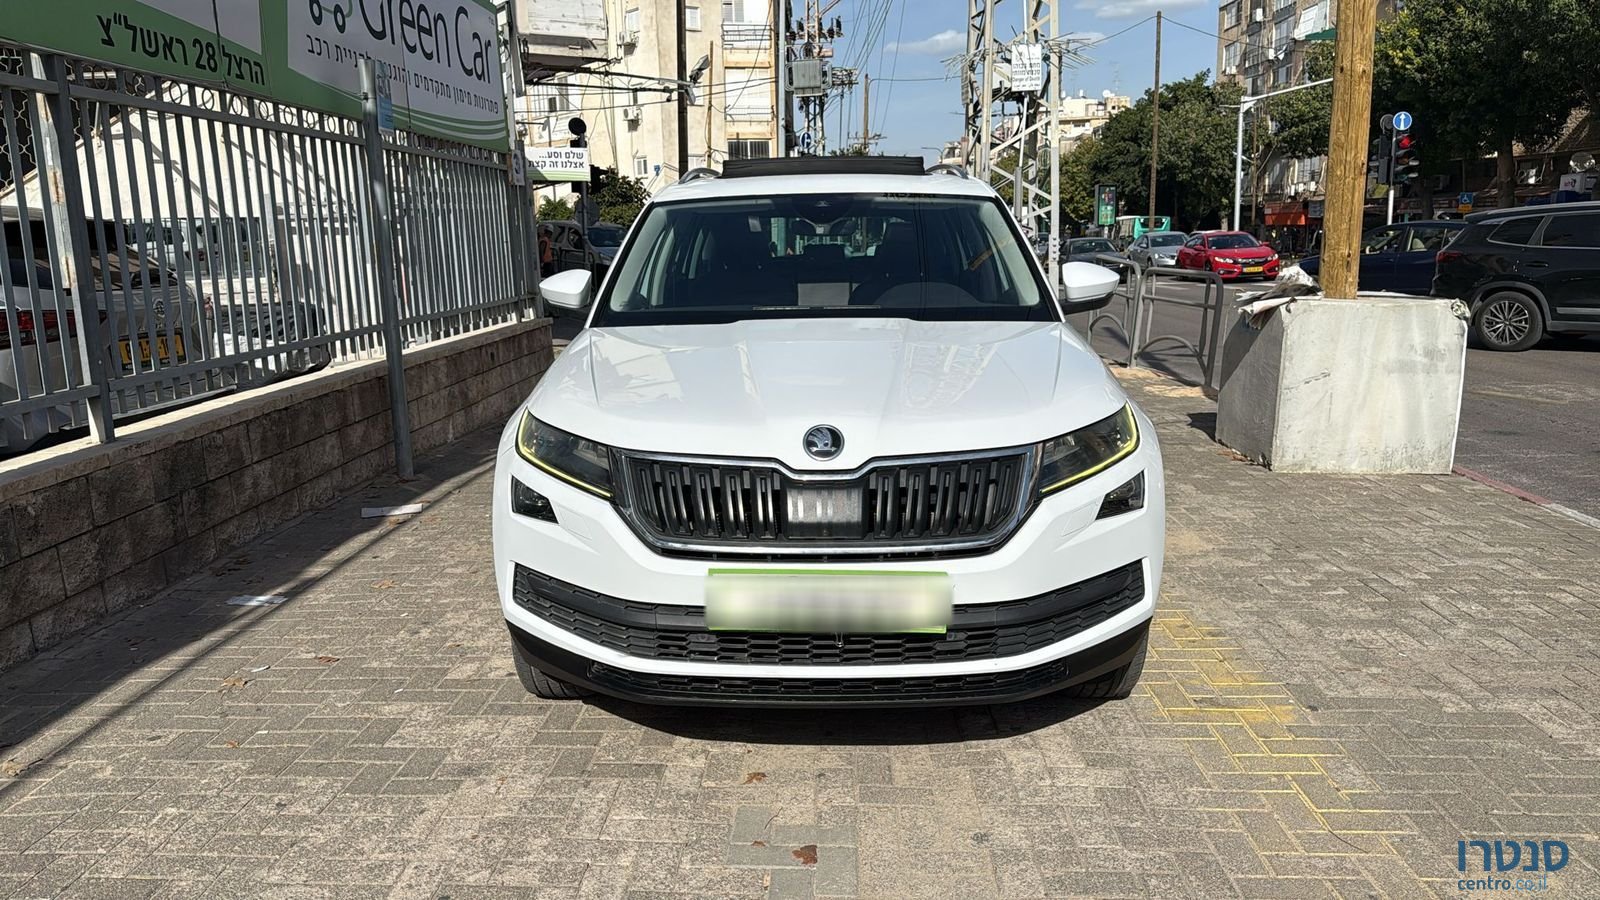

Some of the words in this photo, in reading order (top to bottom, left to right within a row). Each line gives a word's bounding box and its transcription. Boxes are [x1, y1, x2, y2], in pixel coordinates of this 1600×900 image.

[192, 38, 218, 73] 28
[305, 34, 331, 59] רכב
[335, 44, 372, 68] לניית
[454, 5, 492, 84] Car
[221, 44, 265, 86] הרצל
[377, 59, 411, 85] והוגנ
[413, 72, 451, 99] מתקדמים
[452, 86, 472, 105] מימון
[473, 94, 499, 114] פתרונות
[528, 160, 547, 169] קצת
[549, 160, 558, 168] זה
[561, 160, 584, 169] אצלנו
[565, 150, 584, 159] שלם
